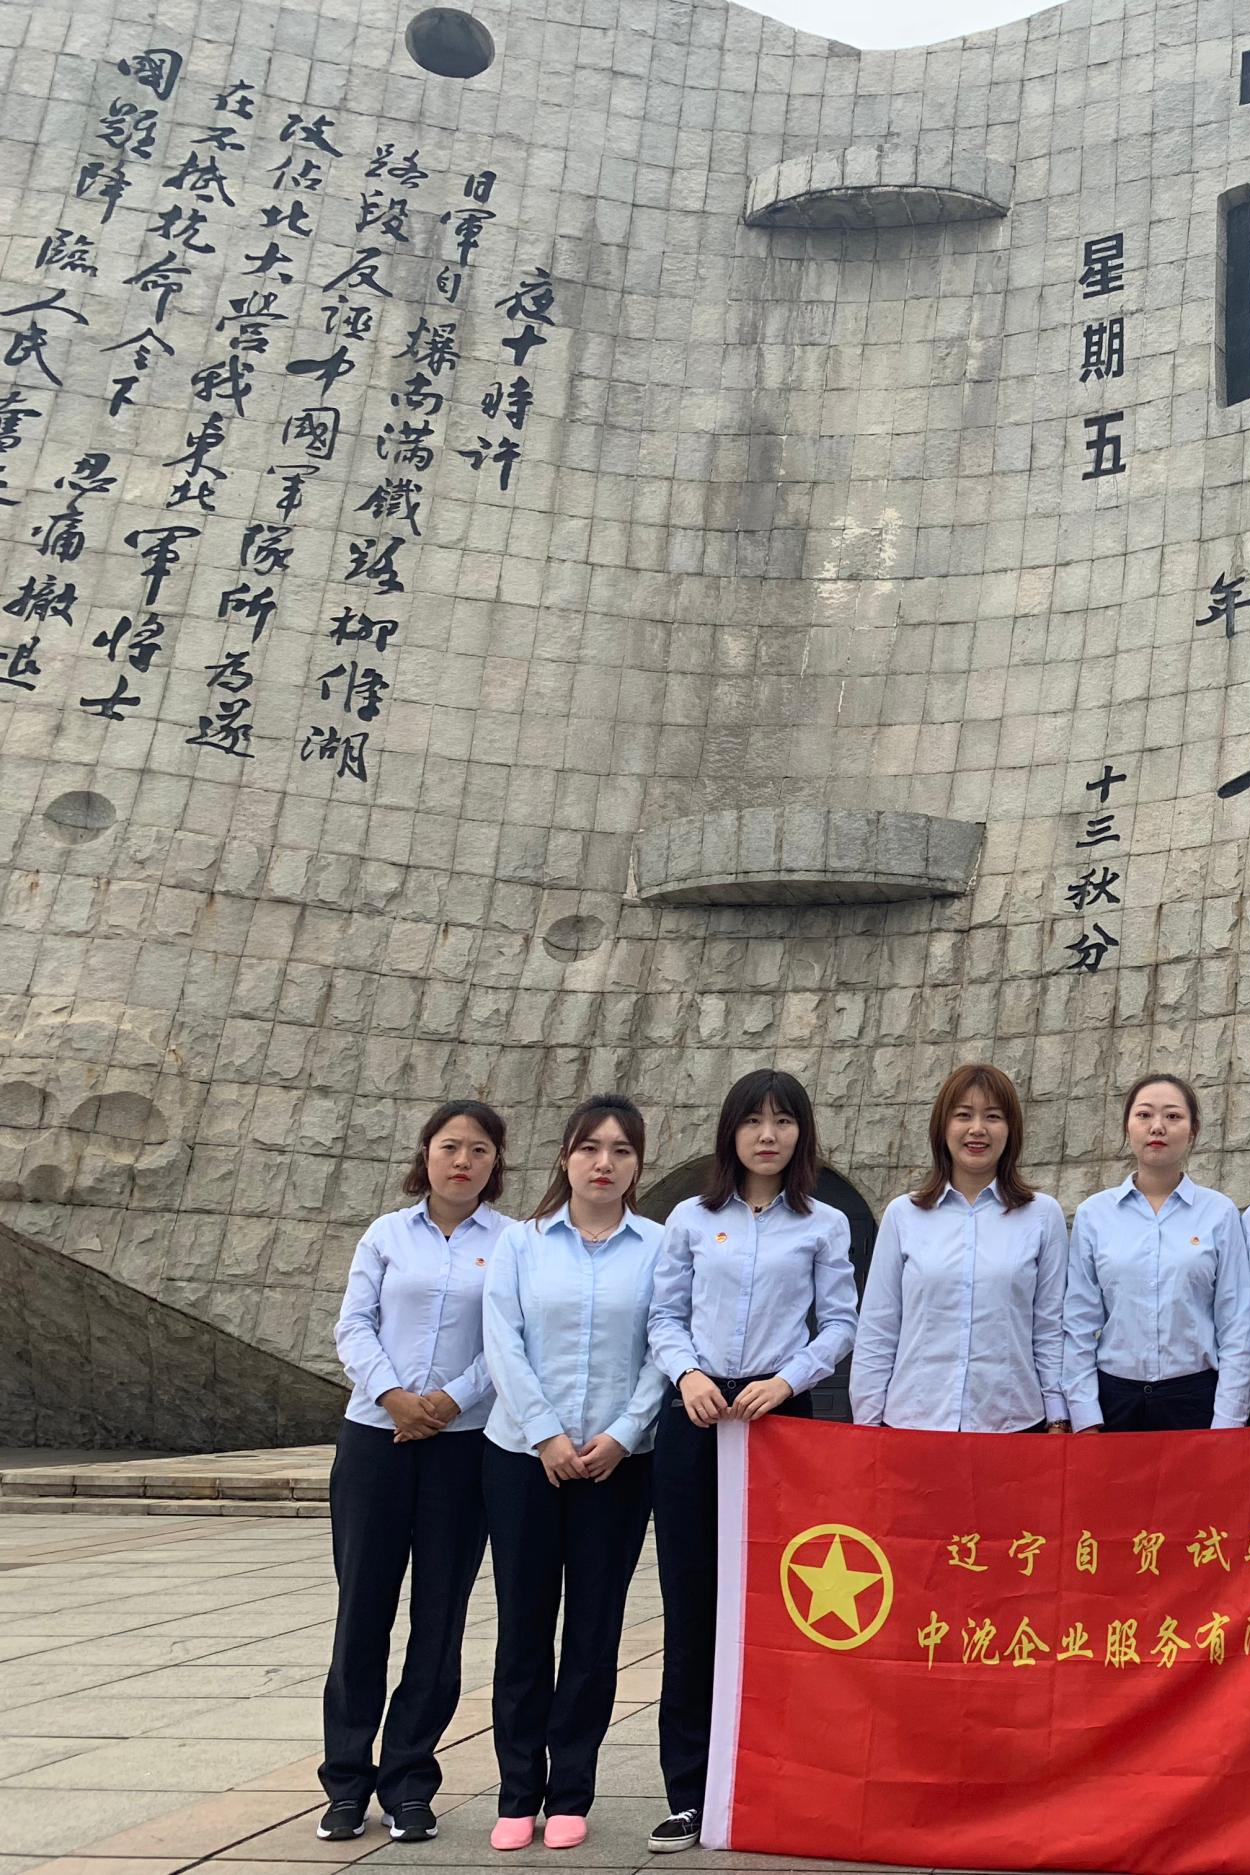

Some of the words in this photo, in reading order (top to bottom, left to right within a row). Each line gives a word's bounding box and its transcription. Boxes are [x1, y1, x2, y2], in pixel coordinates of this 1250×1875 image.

[1079, 232, 1126, 481] 星期五
[1063, 765, 1127, 974] 十三秋分
